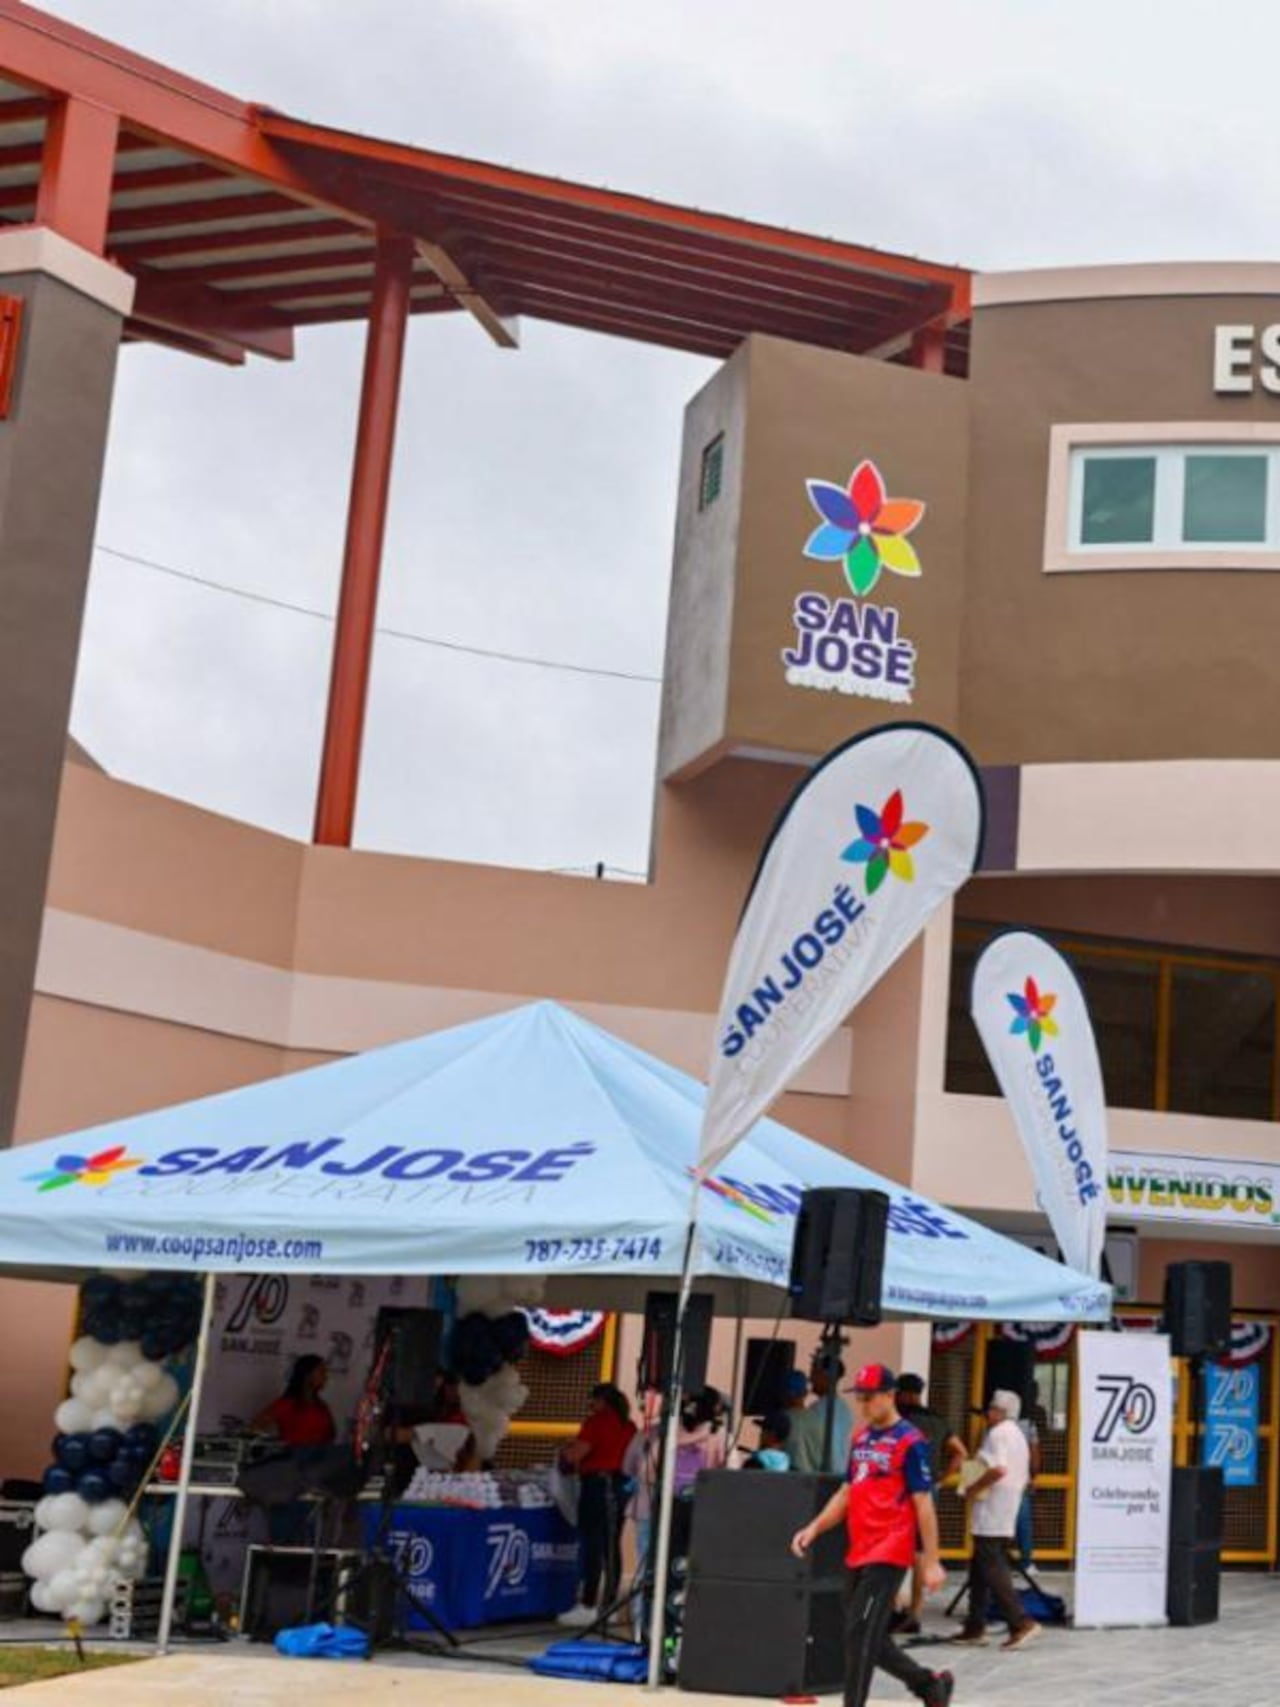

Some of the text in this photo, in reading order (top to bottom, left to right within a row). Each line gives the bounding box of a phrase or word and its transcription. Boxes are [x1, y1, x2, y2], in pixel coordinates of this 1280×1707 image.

[797, 595, 898, 644] SAN
[784, 632, 913, 685] JOSÉ
[721, 884, 866, 1058] SAN JOSÉ
[138, 1138, 597, 1183] SAN JOSÉ
[106, 1232, 662, 1262] www.coopsanjose.com 787-735-7474
[1092, 1375, 1156, 1443] 70
[484, 1523, 529, 1599] 70
